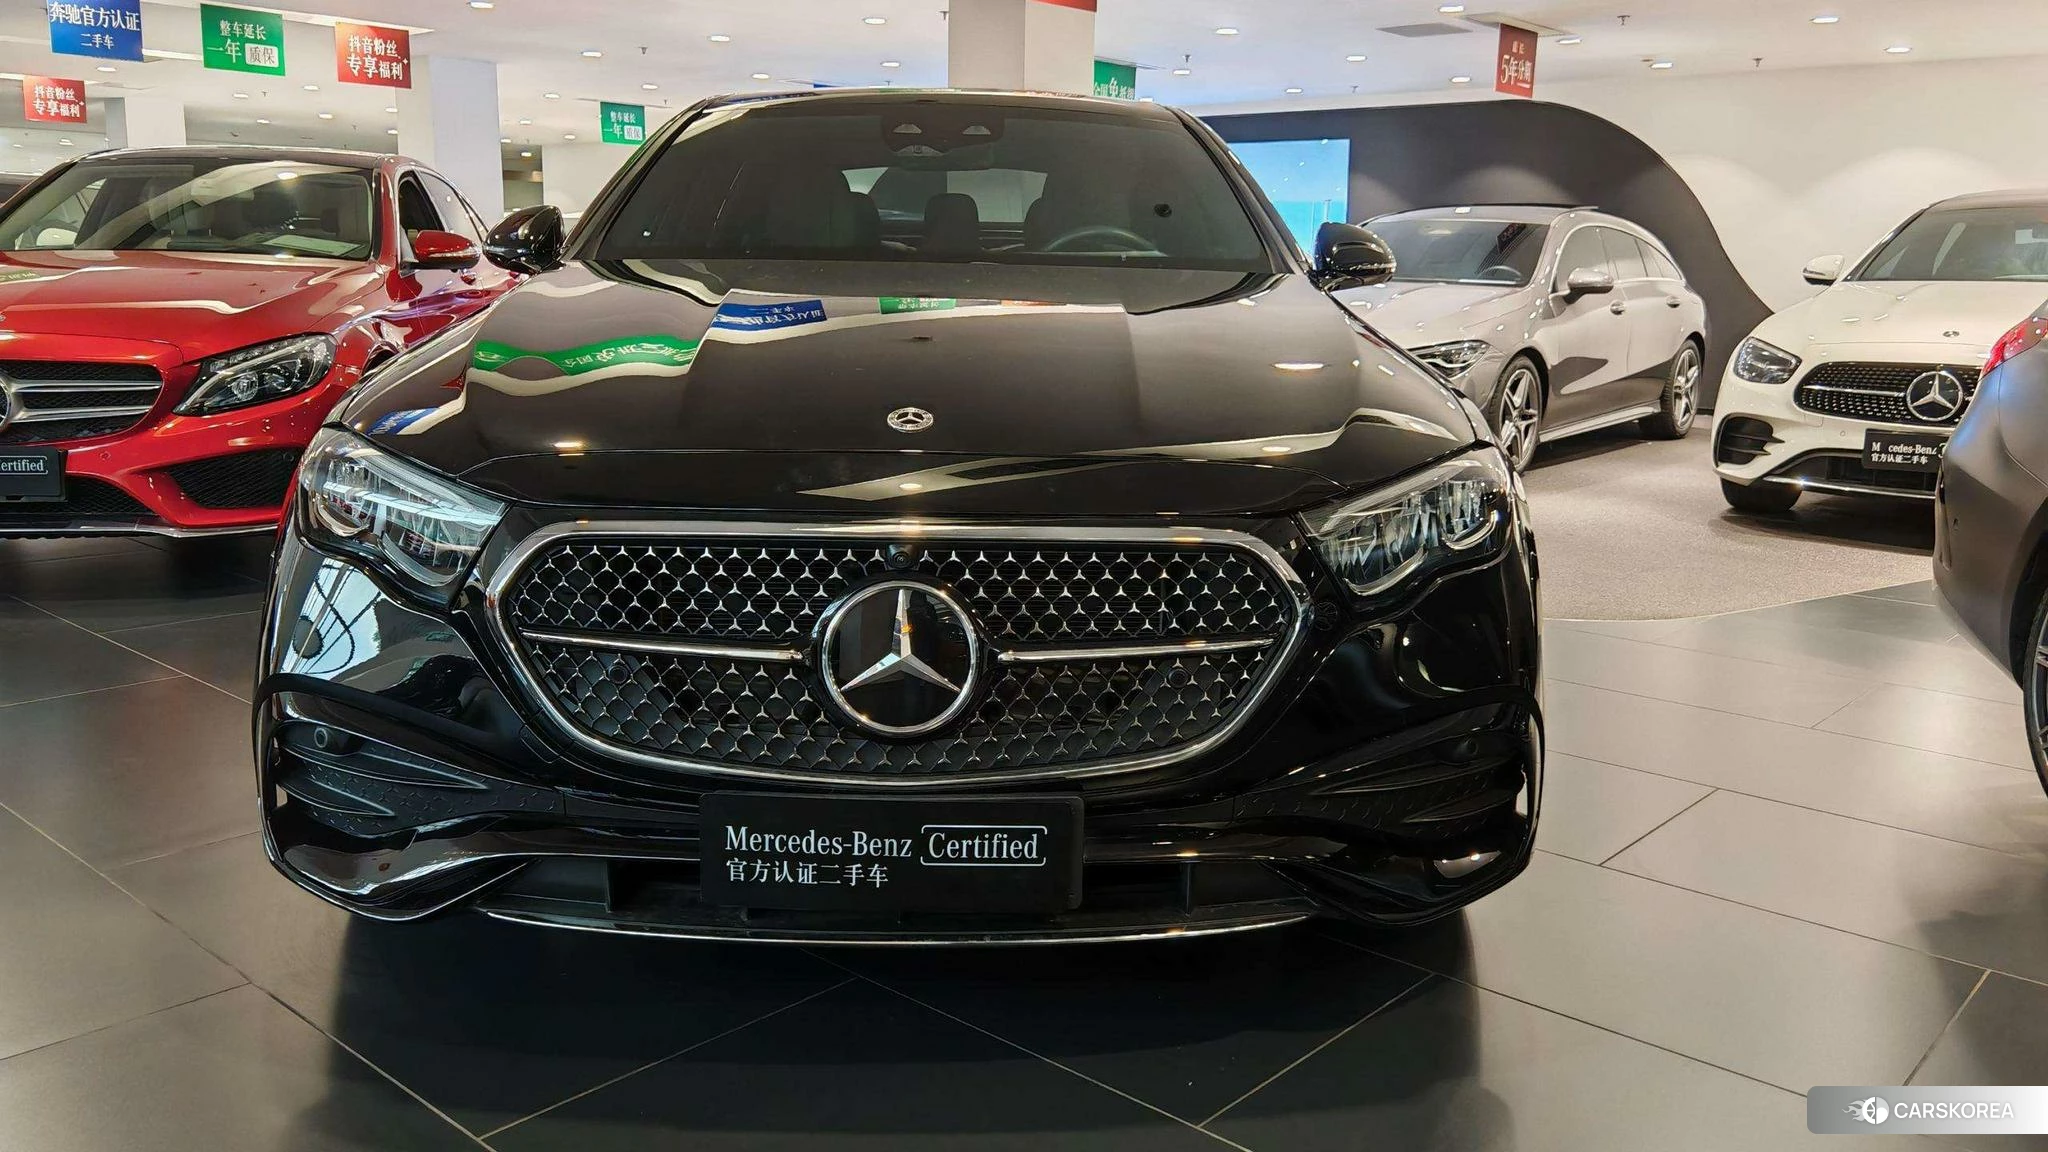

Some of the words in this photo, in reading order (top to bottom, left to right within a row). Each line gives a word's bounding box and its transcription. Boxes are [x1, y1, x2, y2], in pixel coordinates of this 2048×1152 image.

[49, 2, 140, 31] 奔驰官方认证
[81, 33, 114, 49] 二手车
[220, 19, 266, 40] 整车延长
[207, 38, 242, 63] 一年
[249, 46, 275, 64] 质保
[348, 35, 398, 57] 抖音粉丝
[346, 52, 403, 80] 专享福利
[0, 459, 44, 471] ertified
[1871, 452, 1928, 465] 官方认证二手车
[725, 825, 912, 857] Mercedes-Benz
[928, 832, 1038, 859] Certified
[726, 857, 889, 888] 官方认证二手车
